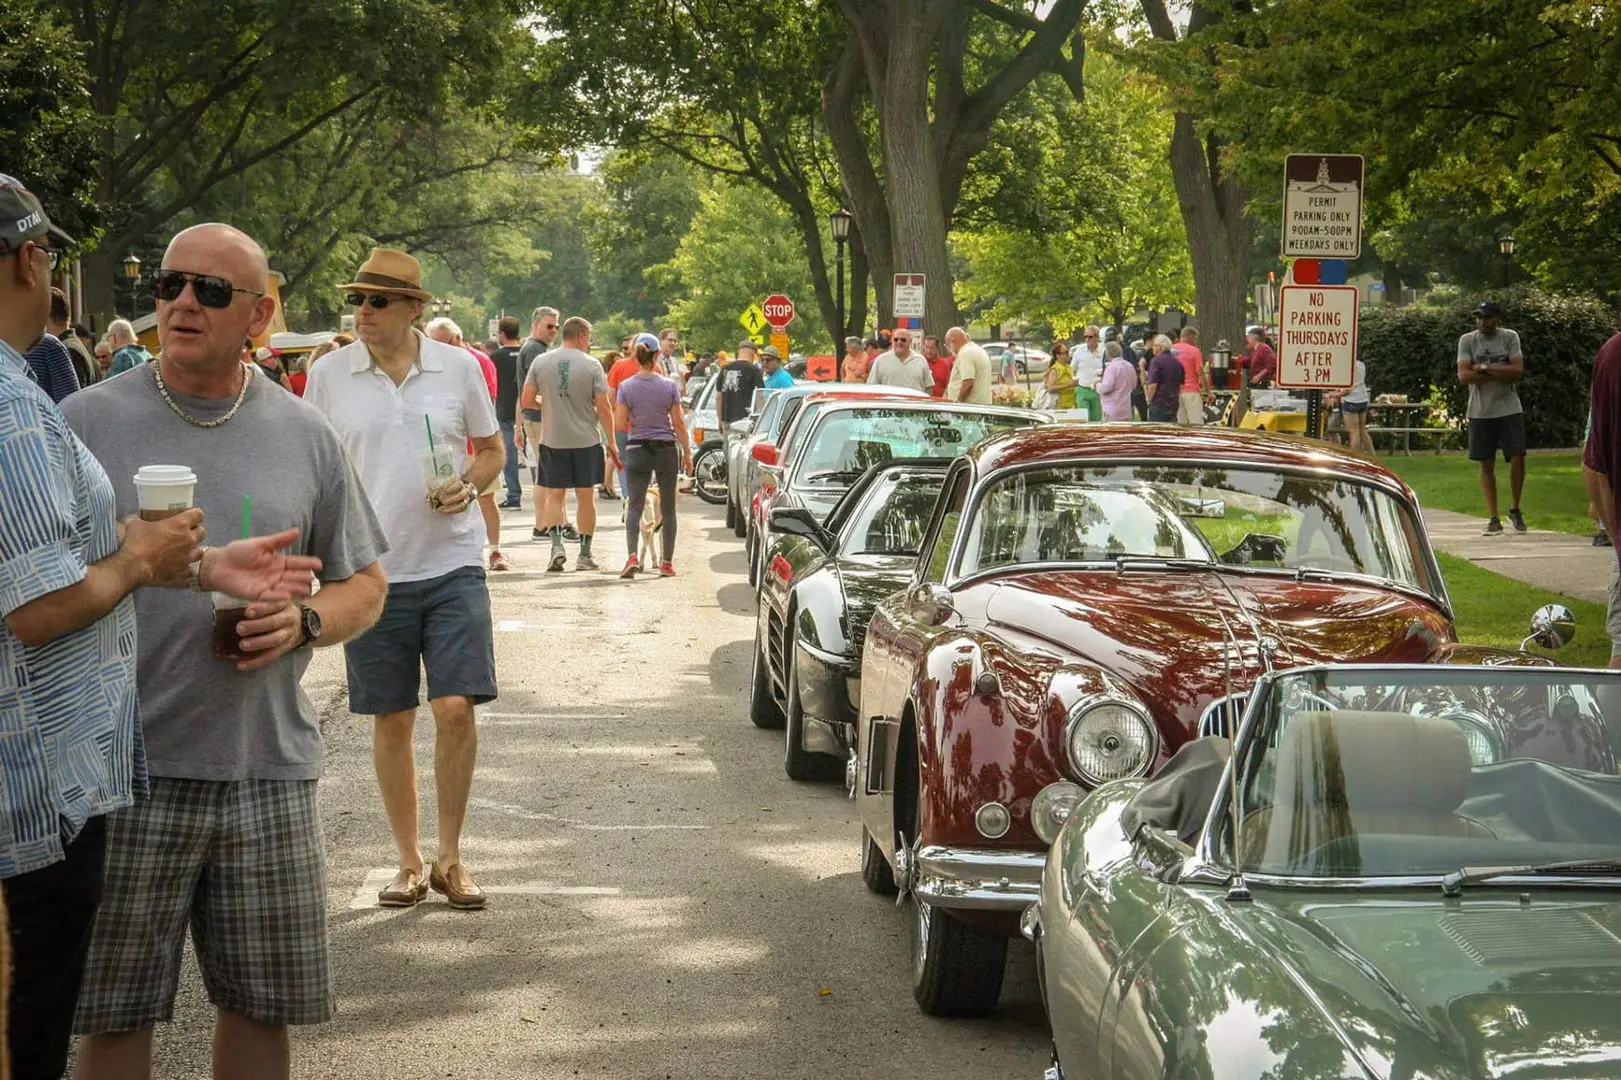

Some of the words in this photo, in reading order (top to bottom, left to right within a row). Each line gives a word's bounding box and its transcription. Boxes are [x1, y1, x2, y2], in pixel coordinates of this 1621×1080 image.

[1309, 197, 1336, 208] PERMIT
[16, 210, 42, 233] DTM
[1294, 211, 1326, 221] PARKING
[1330, 211, 1351, 222] ONLY
[1289, 239, 1330, 250] WEEKDAYS
[1333, 240, 1355, 251] ONLY
[1309, 292, 1324, 307] NO
[764, 304, 792, 317] STOP
[1291, 311, 1341, 327] PARKING
[1286, 330, 1348, 346] THURSDAYS
[1295, 352, 1332, 366] AFTER
[1303, 368, 1310, 383] 3
[1315, 368, 1331, 383] PM
